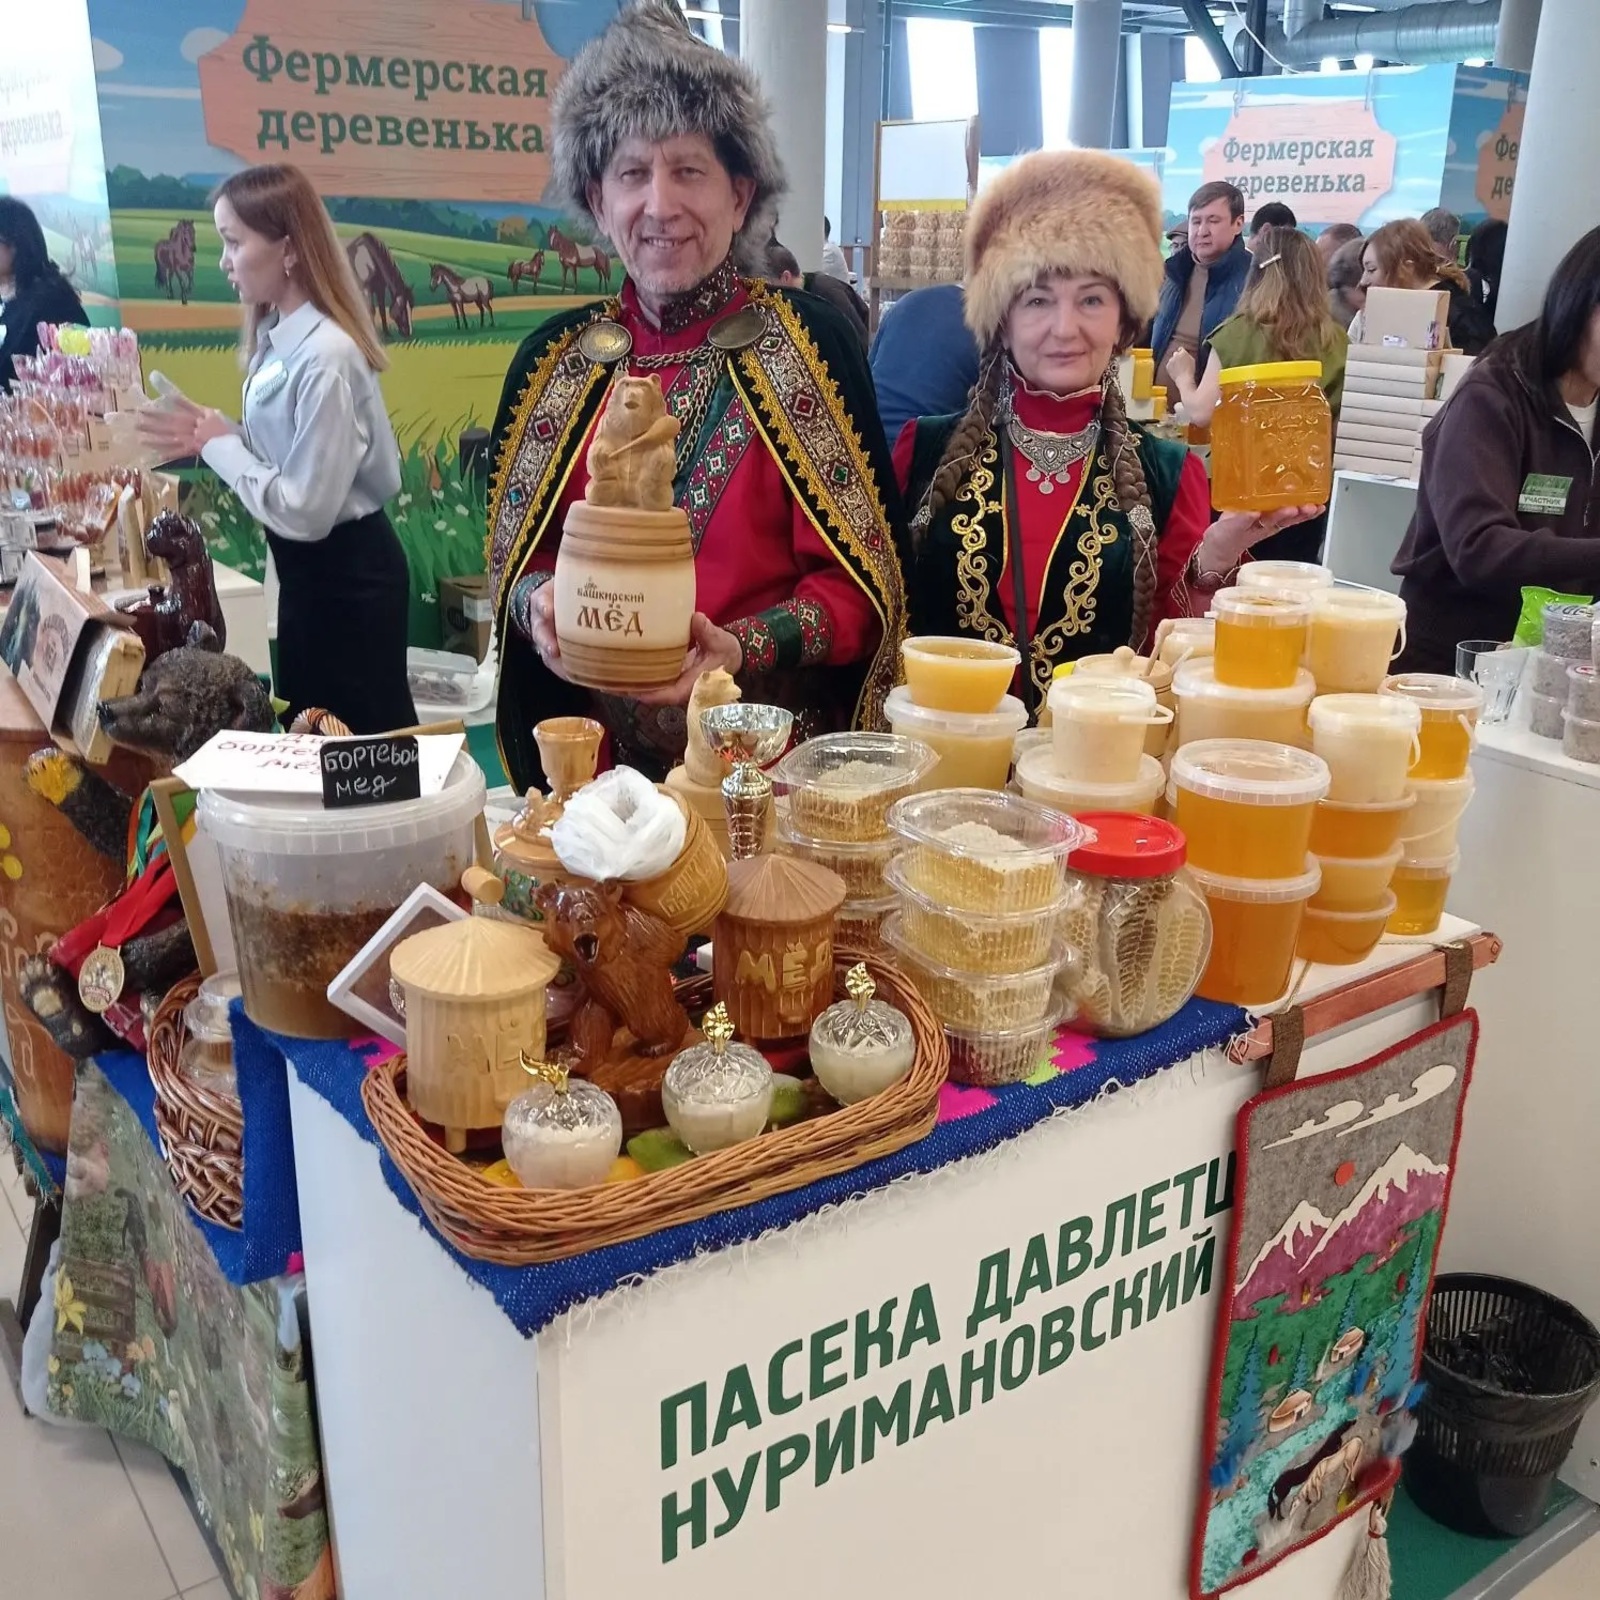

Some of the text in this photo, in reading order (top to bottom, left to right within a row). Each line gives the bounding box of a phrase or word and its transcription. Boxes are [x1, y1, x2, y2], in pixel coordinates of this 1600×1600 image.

[242, 35, 548, 100] Фермерская
[257, 108, 545, 154] деревенька
[1223, 137, 1375, 167] Фермерская
[217, 740, 320, 756] борте
[659, 1282, 941, 1470] ПАСЕКА
[660, 1226, 1216, 1564] НУРИМАНОВСКИЙ
